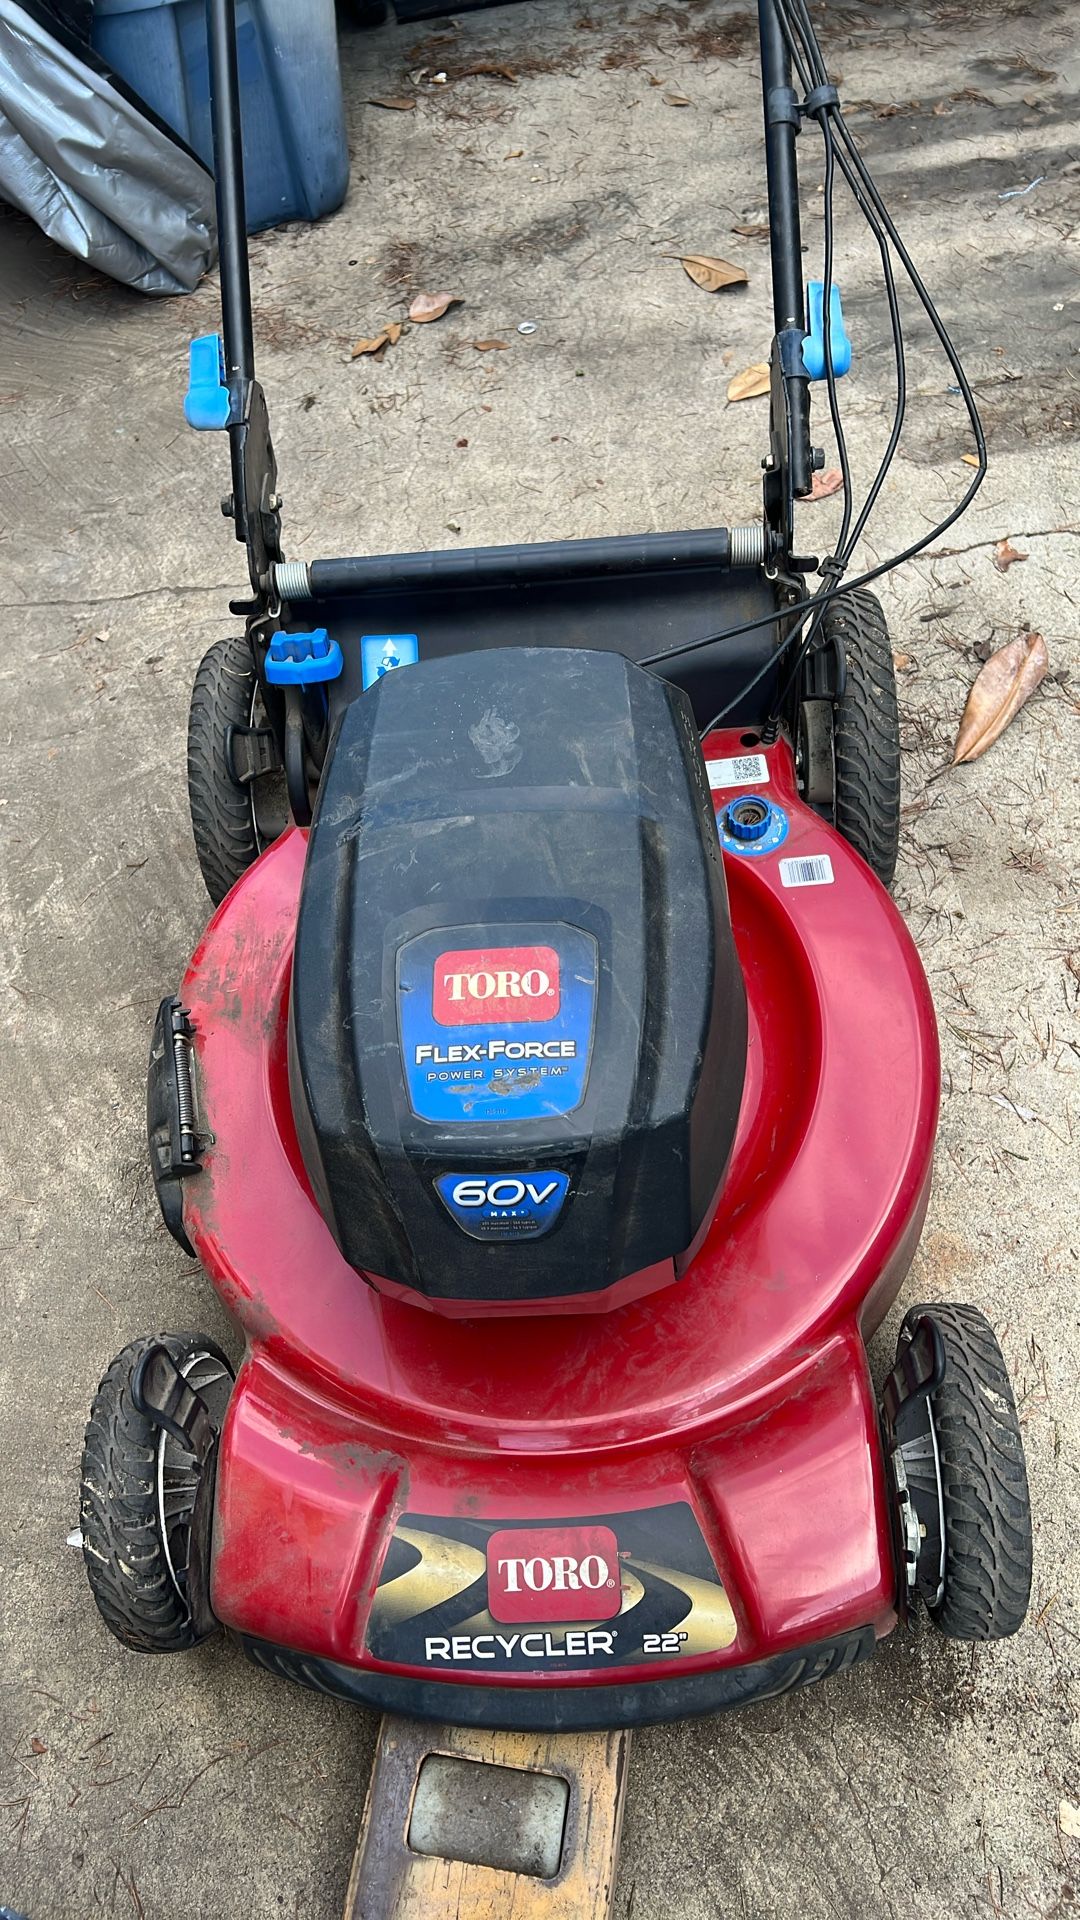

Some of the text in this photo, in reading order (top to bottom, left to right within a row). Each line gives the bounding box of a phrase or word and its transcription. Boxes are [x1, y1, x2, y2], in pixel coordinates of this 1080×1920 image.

[443, 969, 550, 1001] TORO
[415, 1040, 576, 1064] FLEX-FORCE
[427, 1066, 562, 1081] POWER SYSTEM
[497, 1555, 610, 1593] TORO
[425, 1632, 688, 1660] RECYCLER 22"
